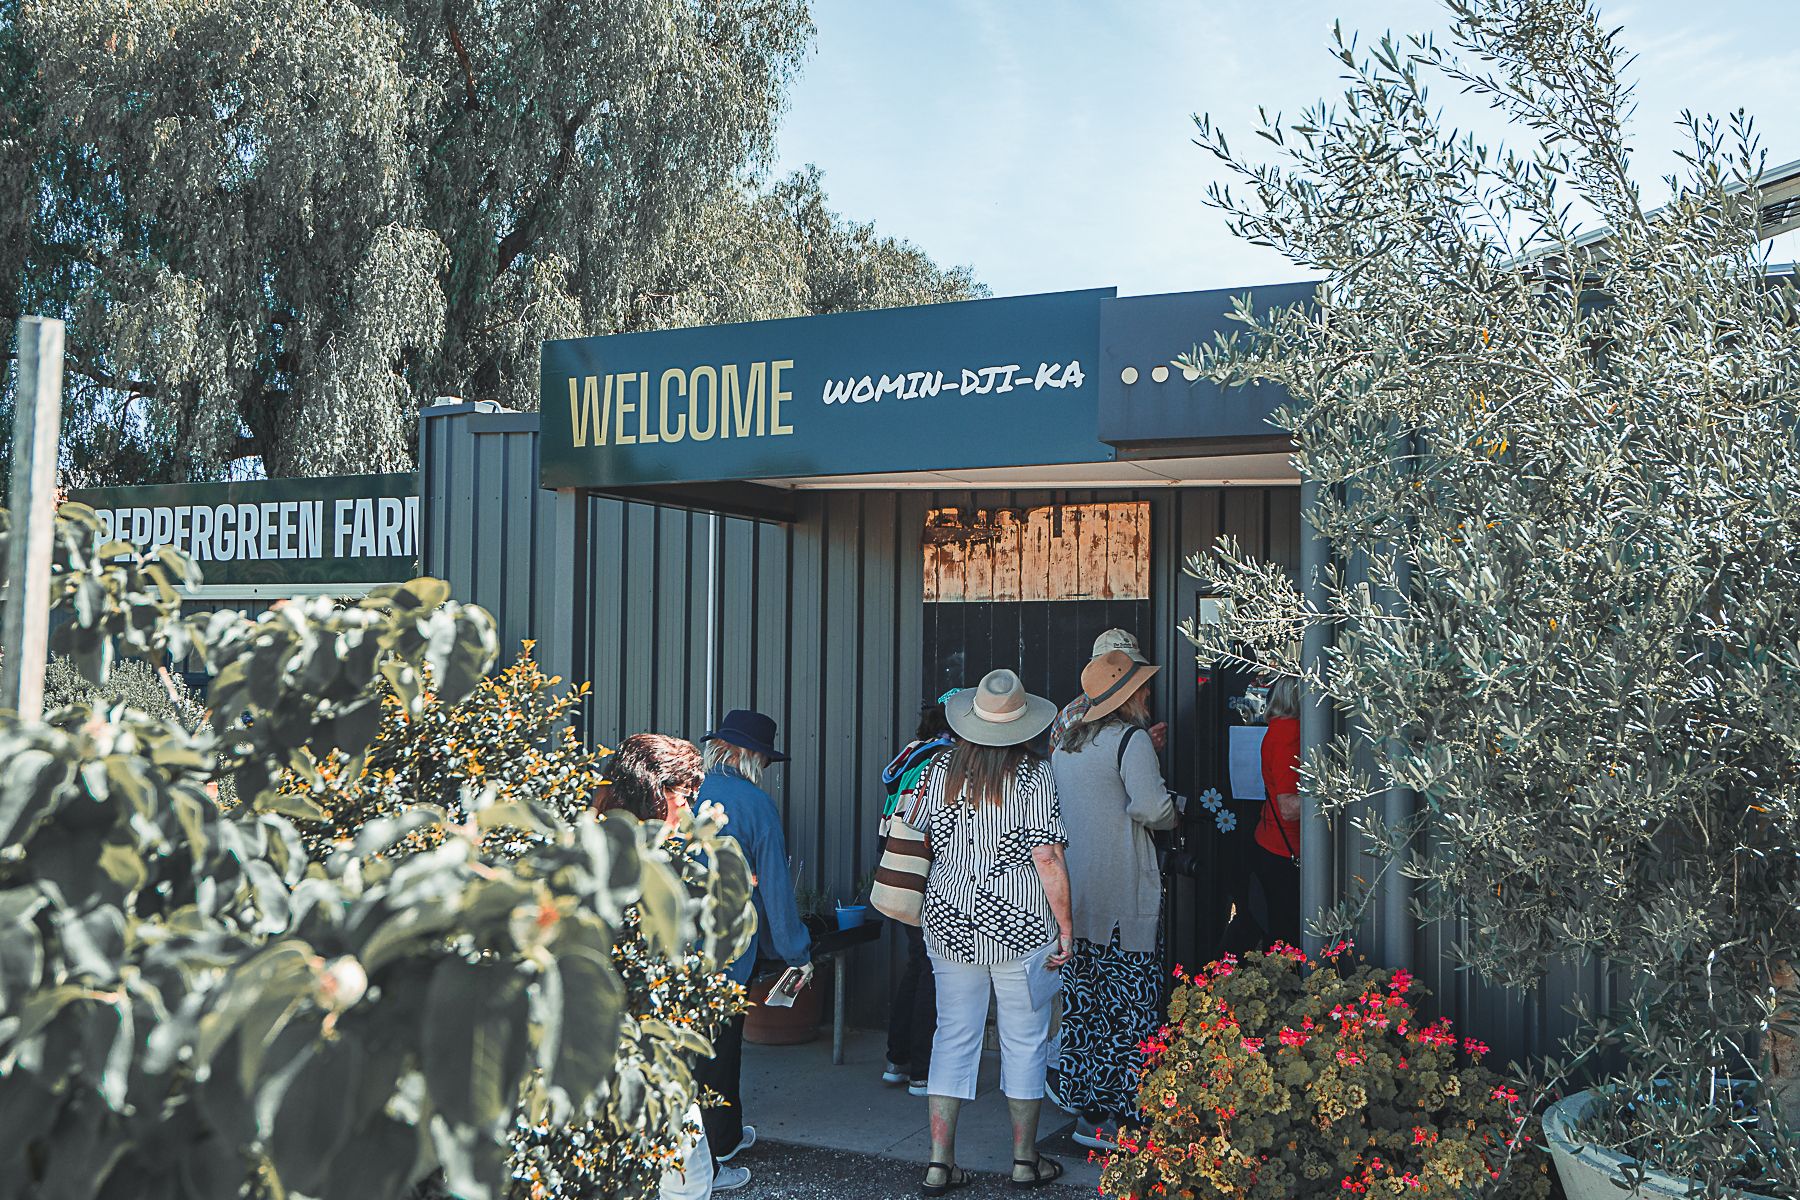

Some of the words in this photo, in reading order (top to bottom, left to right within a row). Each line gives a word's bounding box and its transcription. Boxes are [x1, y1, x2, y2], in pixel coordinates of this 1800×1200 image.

[568, 359, 794, 447] WELCOME
[822, 360, 1086, 405] WOMIN-DJI-KA
[94, 501, 324, 562] PEPPERGREEN
